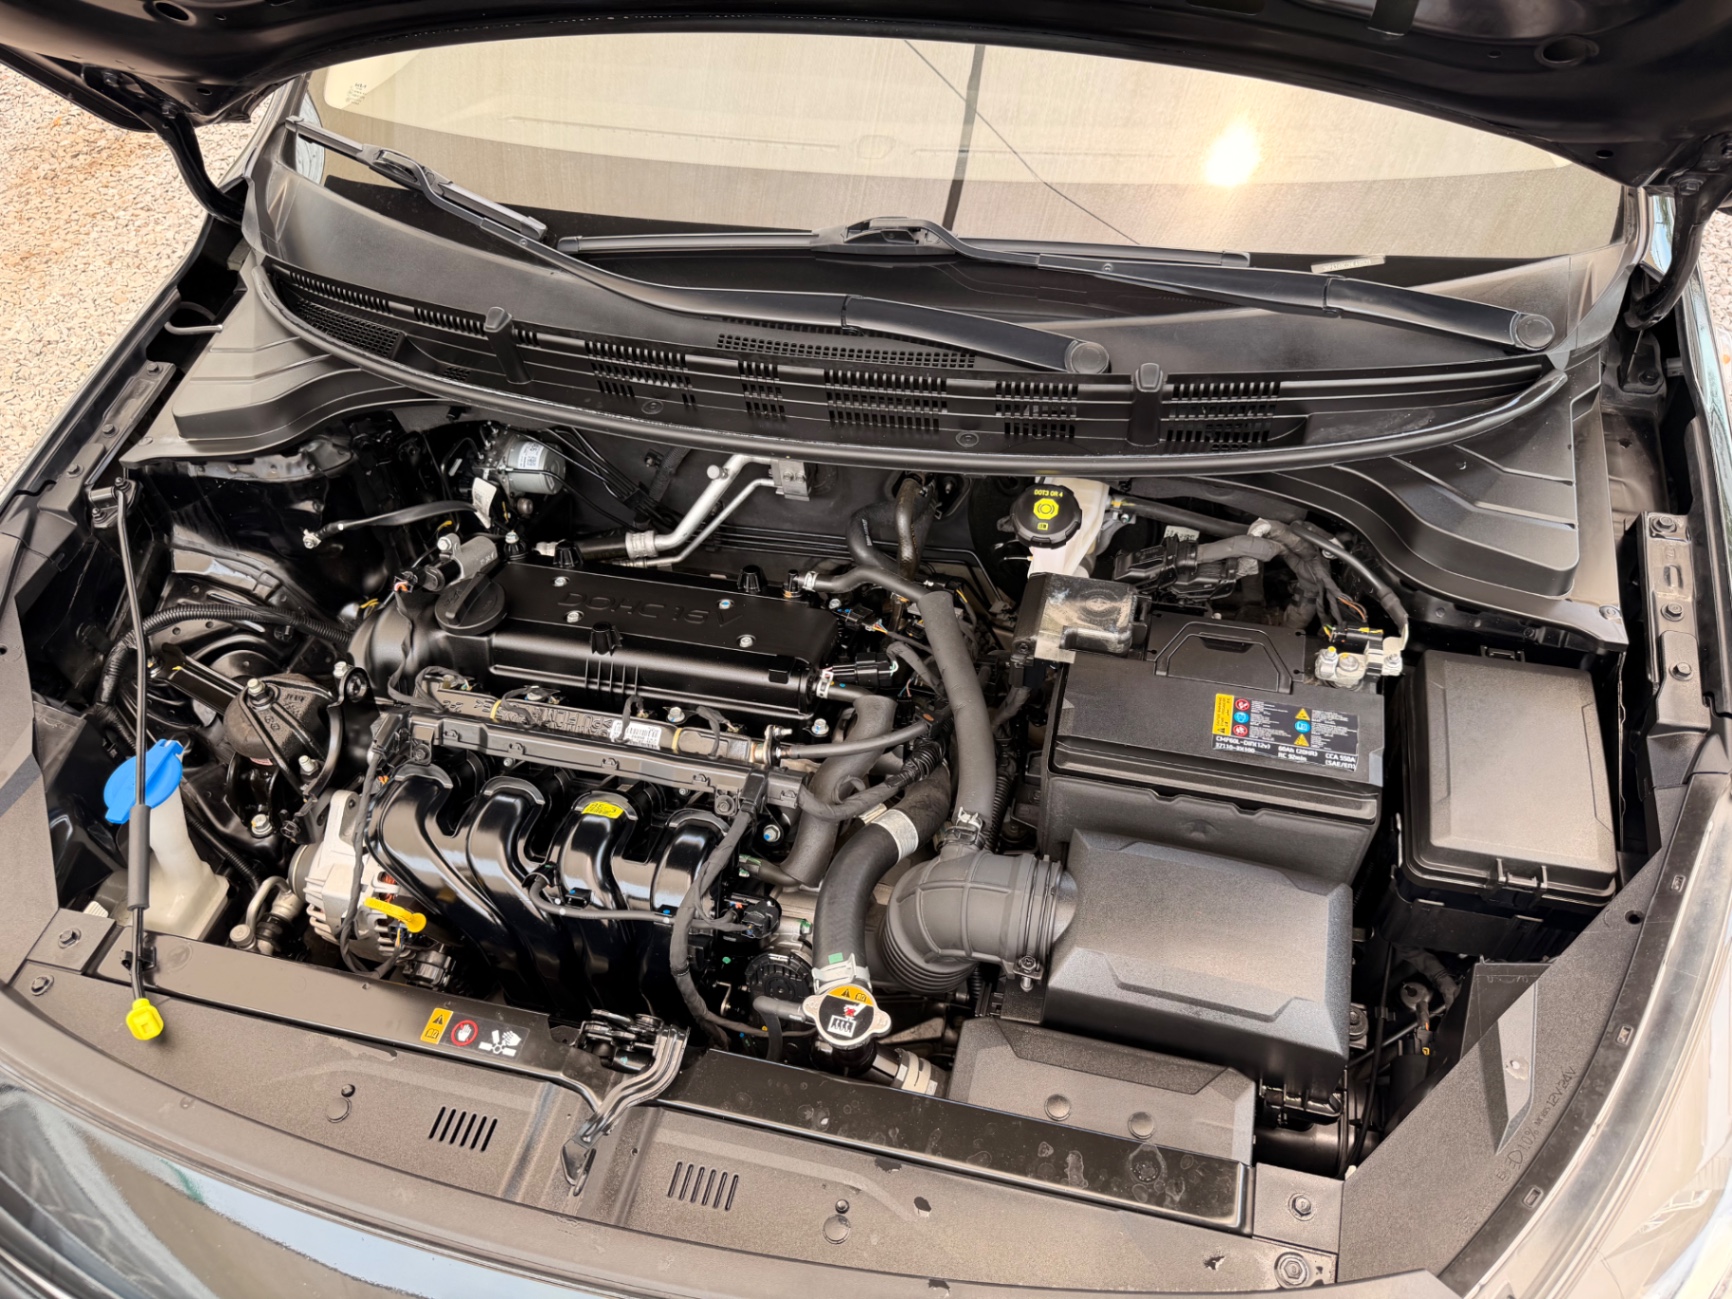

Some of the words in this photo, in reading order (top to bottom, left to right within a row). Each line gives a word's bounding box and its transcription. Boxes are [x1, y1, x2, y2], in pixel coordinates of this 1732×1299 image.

[557, 593, 666, 619] DOHC
[672, 606, 743, 628] 16V
[1325, 752, 1338, 760] CCA
